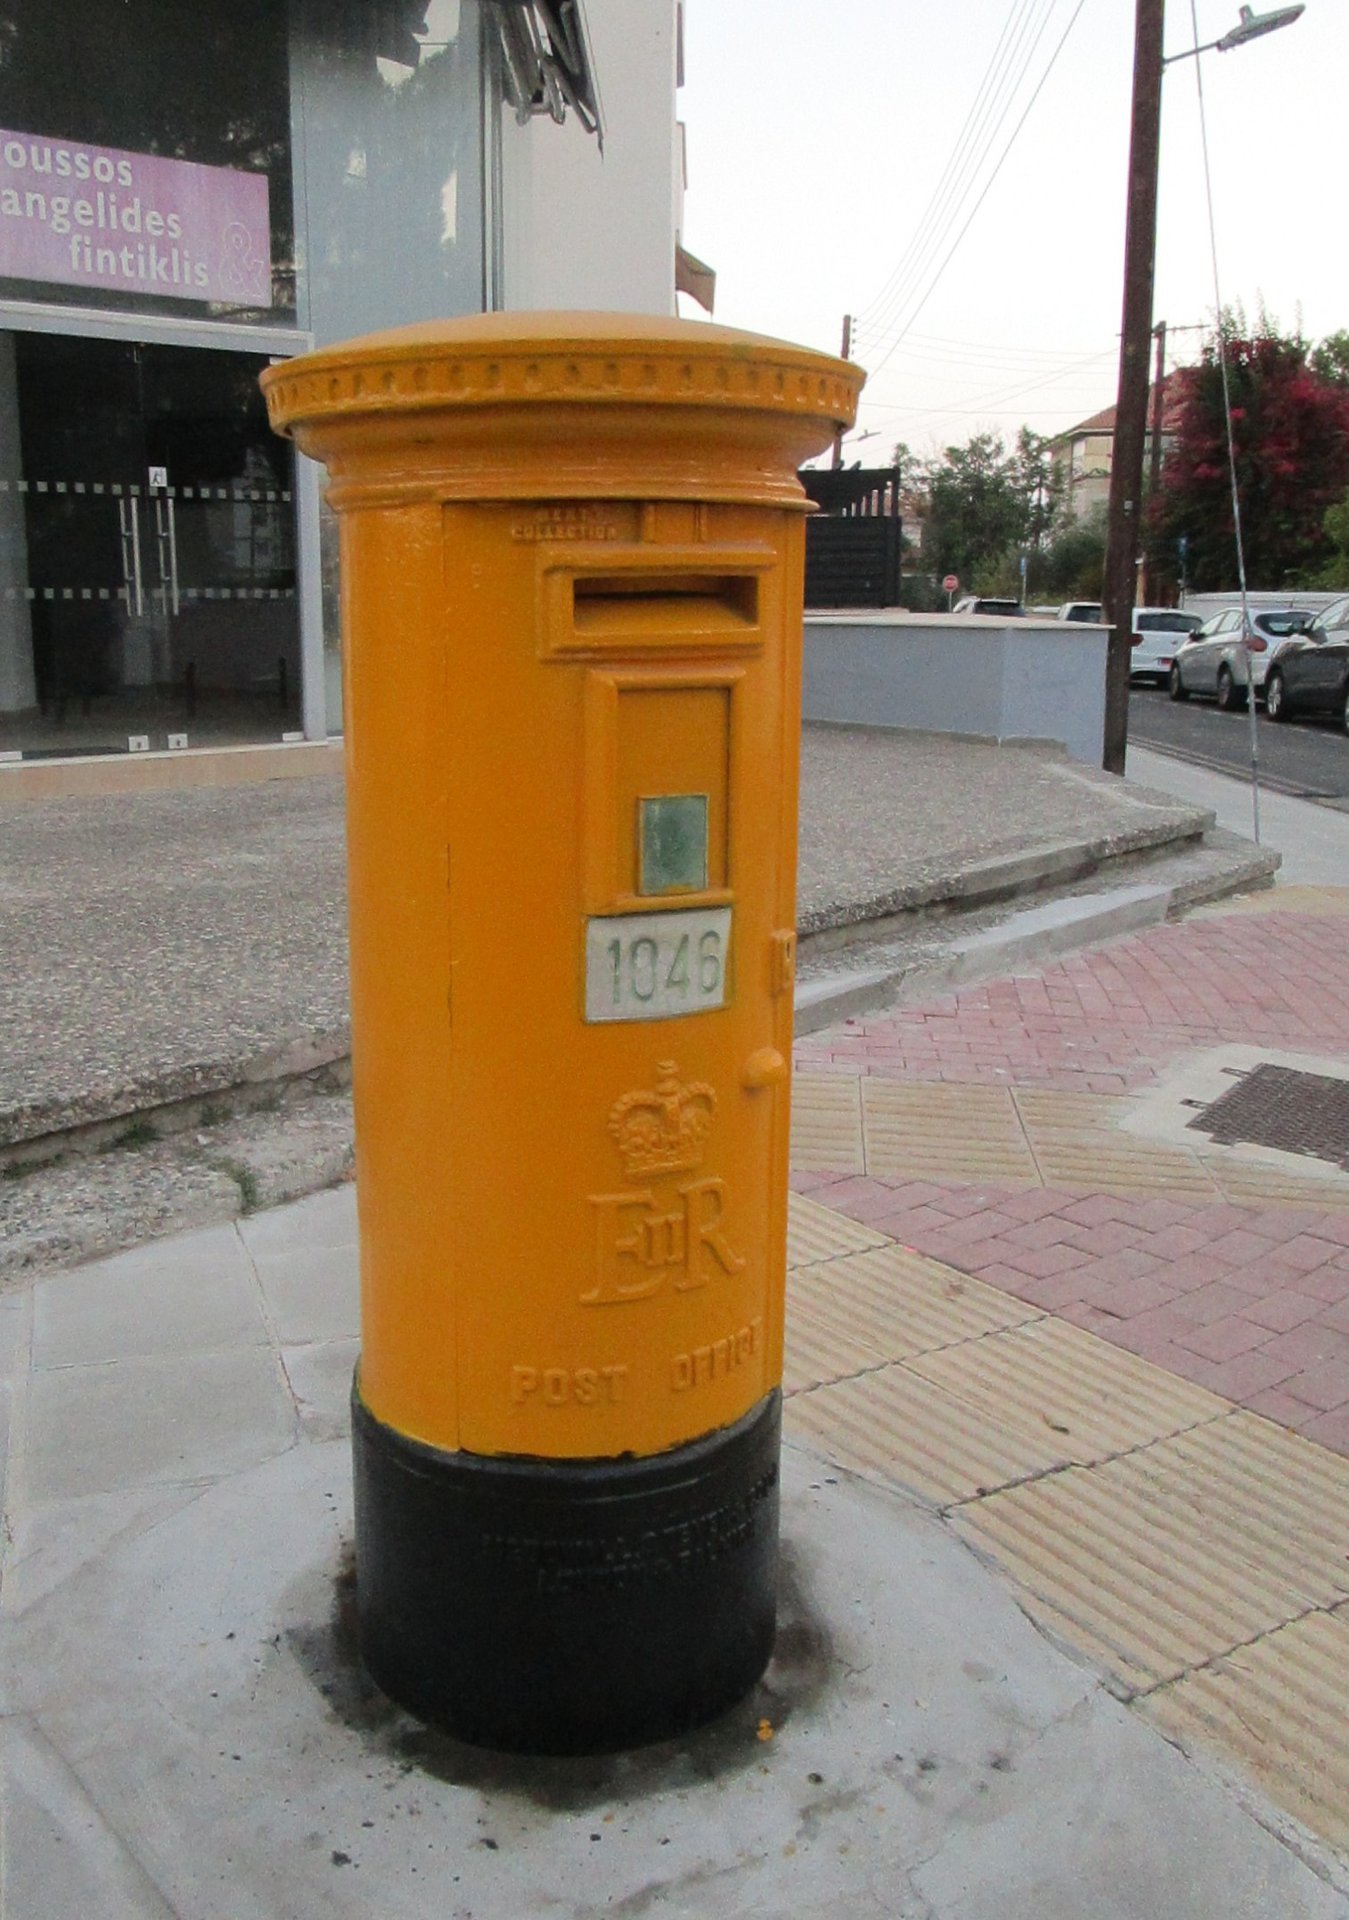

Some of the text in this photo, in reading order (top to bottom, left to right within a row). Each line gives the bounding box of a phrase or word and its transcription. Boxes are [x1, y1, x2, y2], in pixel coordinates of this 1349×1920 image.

[1, 188, 183, 239] angelides
[69, 234, 209, 288] fintiklis
[606, 929, 722, 1004] 1046
[512, 1364, 628, 1406] POST
